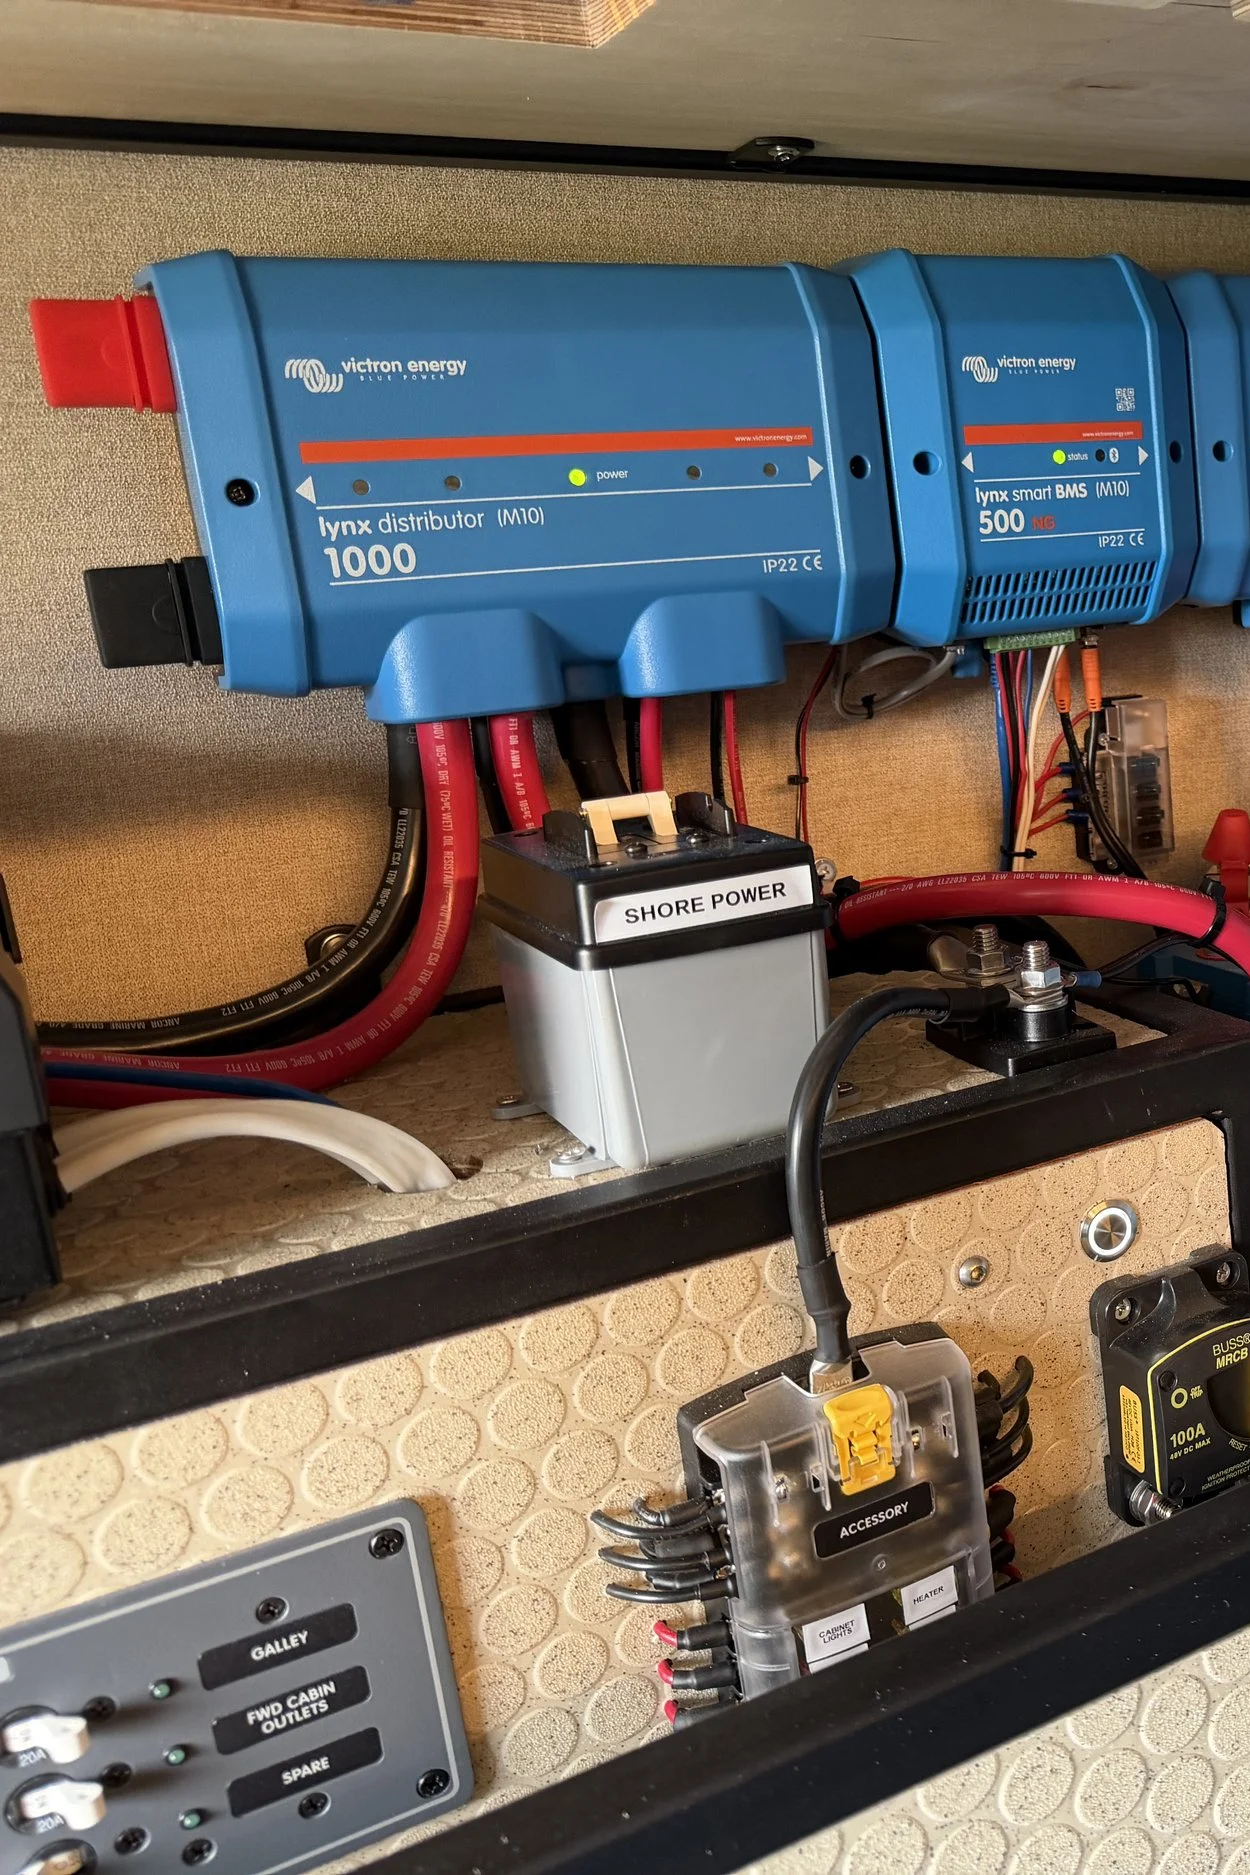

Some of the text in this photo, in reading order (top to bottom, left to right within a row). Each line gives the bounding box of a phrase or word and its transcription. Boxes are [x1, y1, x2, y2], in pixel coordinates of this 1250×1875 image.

[341, 358, 467, 379] victron energy
[997, 355, 1077, 371] victron energy
[360, 373, 446, 382] BLUE POWER
[734, 432, 808, 444] www.victronenergy.com
[1067, 451, 1089, 461] status
[596, 468, 629, 482] power
[975, 480, 1130, 507] lynx smart BMS (M10)
[318, 506, 546, 541] lynx distributor (M10)
[979, 508, 1057, 535] 500 NG
[1098, 535, 1125, 548] IP22
[323, 543, 417, 579] 1000
[762, 558, 798, 574] IP22
[510, 749, 521, 769] AWM
[438, 769, 449, 785] DRY
[443, 835, 454, 847] OIL
[390, 852, 402, 867] CSA
[443, 850, 454, 888] RESISTANT
[385, 869, 398, 886] TEW
[900, 884, 913, 892] 2/0
[971, 874, 986, 882] CSA
[991, 873, 1008, 881] TEW
[1098, 875, 1120, 883] AWM
[624, 881, 787, 924] SHORE POWER
[365, 908, 382, 927] 600V
[358, 927, 370, 941] FT1
[347, 938, 359, 950] OR
[328, 948, 349, 967] AWM
[426, 952, 441, 967] CSA
[305, 970, 321, 984] A/B
[417, 968, 434, 986] TEW
[239, 1000, 255, 1012] FT1
[257, 993, 280, 1006] 600V
[220, 1007, 237, 1017] FT2
[71, 1017, 181, 1031] ANCOR MARINE GRADE
[379, 1018, 392, 1032] FT1
[344, 1034, 367, 1052] AWM
[59, 1049, 96, 1060] GRADE
[103, 1055, 142, 1067] MARINE
[224, 1063, 242, 1073] FT2
[245, 1063, 261, 1073] FT1
[1216, 1347, 1249, 1370] MRCB
[1170, 1422, 1206, 1448] 100A
[1169, 1437, 1211, 1460] 48V DC MAX
[1228, 1437, 1249, 1452] RESET
[1201, 1476, 1226, 1491] IGNITION
[839, 1501, 910, 1540] ACCESSORY
[912, 1585, 945, 1605] HEATER
[818, 1618, 856, 1640] CABINET
[822, 1626, 854, 1645] LIGHTS
[250, 1630, 309, 1662] GALLEY
[247, 1681, 337, 1727] FWD CABIN
[261, 1699, 330, 1736] OUTLETS
[281, 1756, 331, 1786] SPARE
